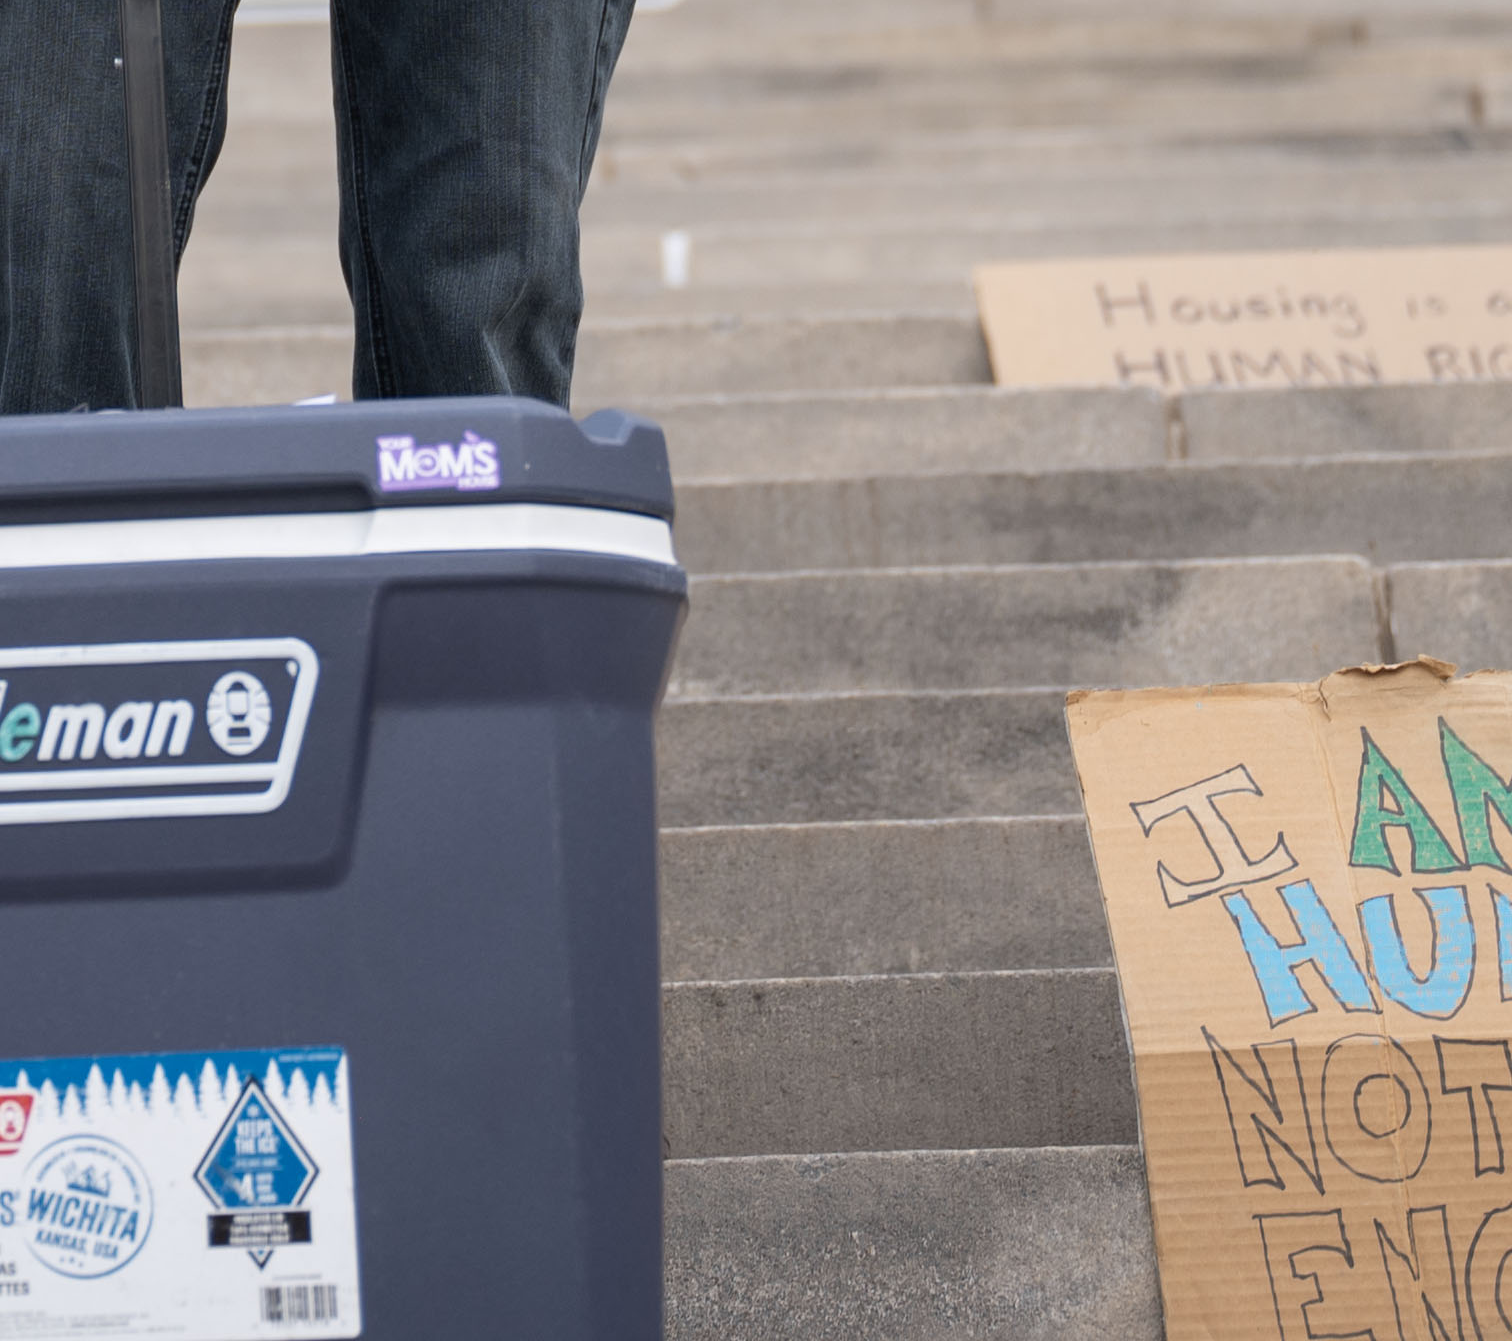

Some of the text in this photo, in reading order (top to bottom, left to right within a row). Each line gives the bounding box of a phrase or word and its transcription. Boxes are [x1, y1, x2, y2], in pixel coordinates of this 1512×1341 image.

[1095, 278, 1367, 339] Housing
[1114, 346, 1383, 388] HUMAN
[1131, 762, 1298, 906] I
[27, 1188, 139, 1243] WICHITA
[93, 1240, 119, 1259] USA
